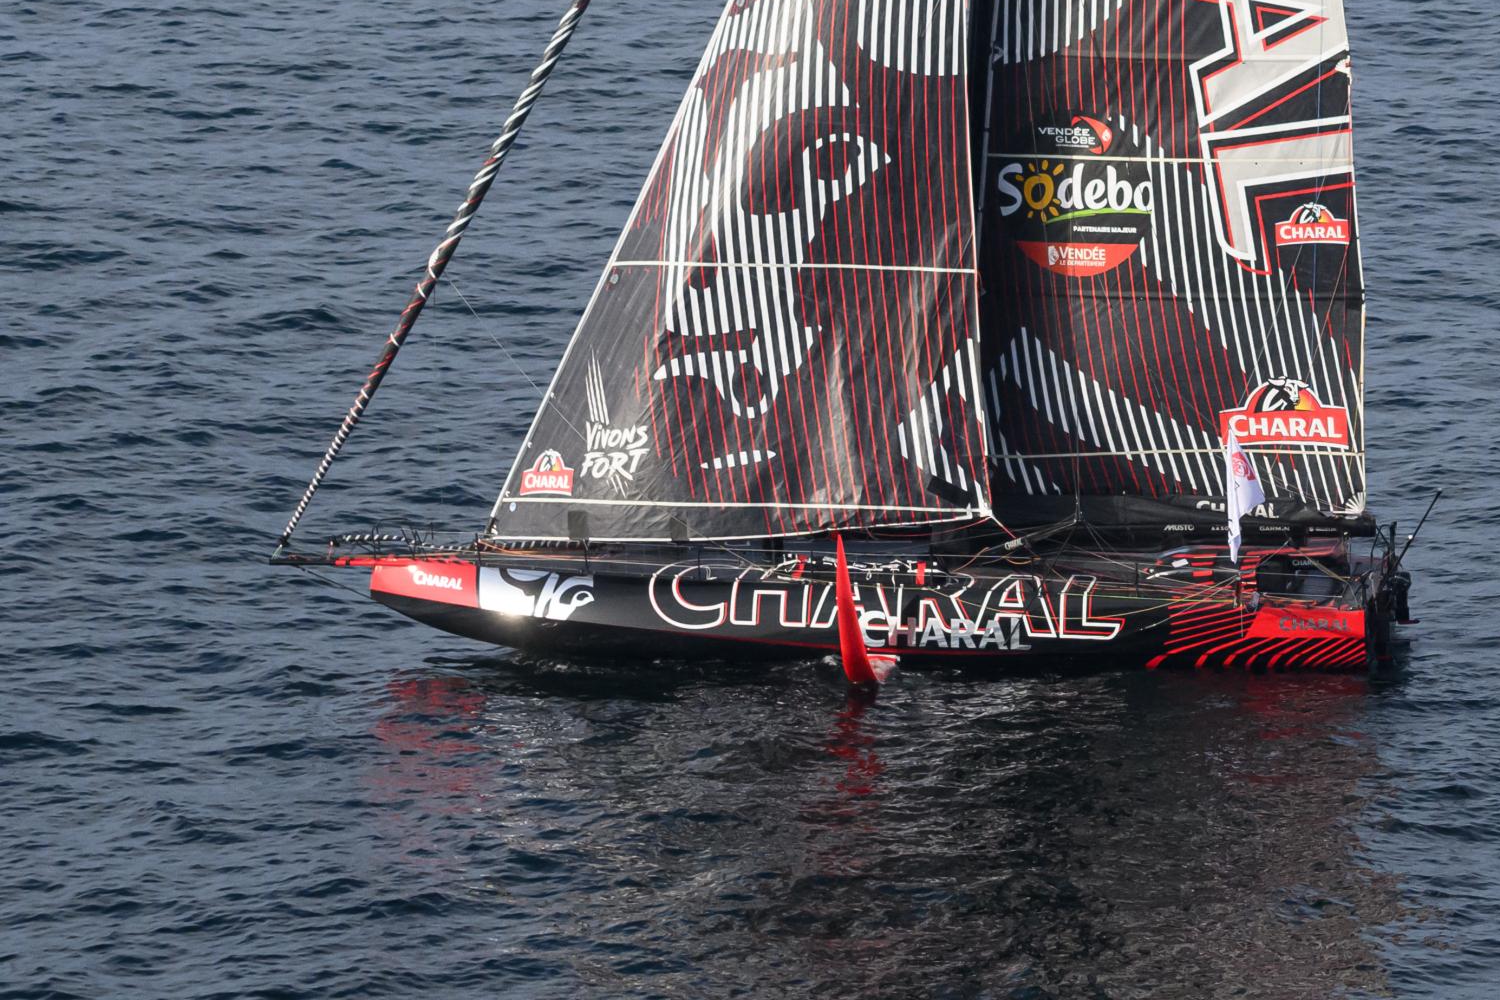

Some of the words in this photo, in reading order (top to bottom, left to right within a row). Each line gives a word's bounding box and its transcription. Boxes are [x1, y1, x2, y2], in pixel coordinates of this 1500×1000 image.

[1038, 126, 1090, 137] VENDÉE
[1055, 135, 1096, 146] GLOBE
[999, 161, 1153, 217] Sodebo
[1279, 224, 1346, 240] CHARAL
[1058, 246, 1106, 261] VENDÉE
[1228, 413, 1342, 438] CHARAL
[580, 449, 650, 480] FORT
[524, 474, 570, 489] CHARAL
[413, 570, 463, 591] CHARAL
[648, 558, 1126, 641] CHARAL
[861, 610, 1032, 651] CHARAL
[1279, 616, 1350, 632] CHARAL
